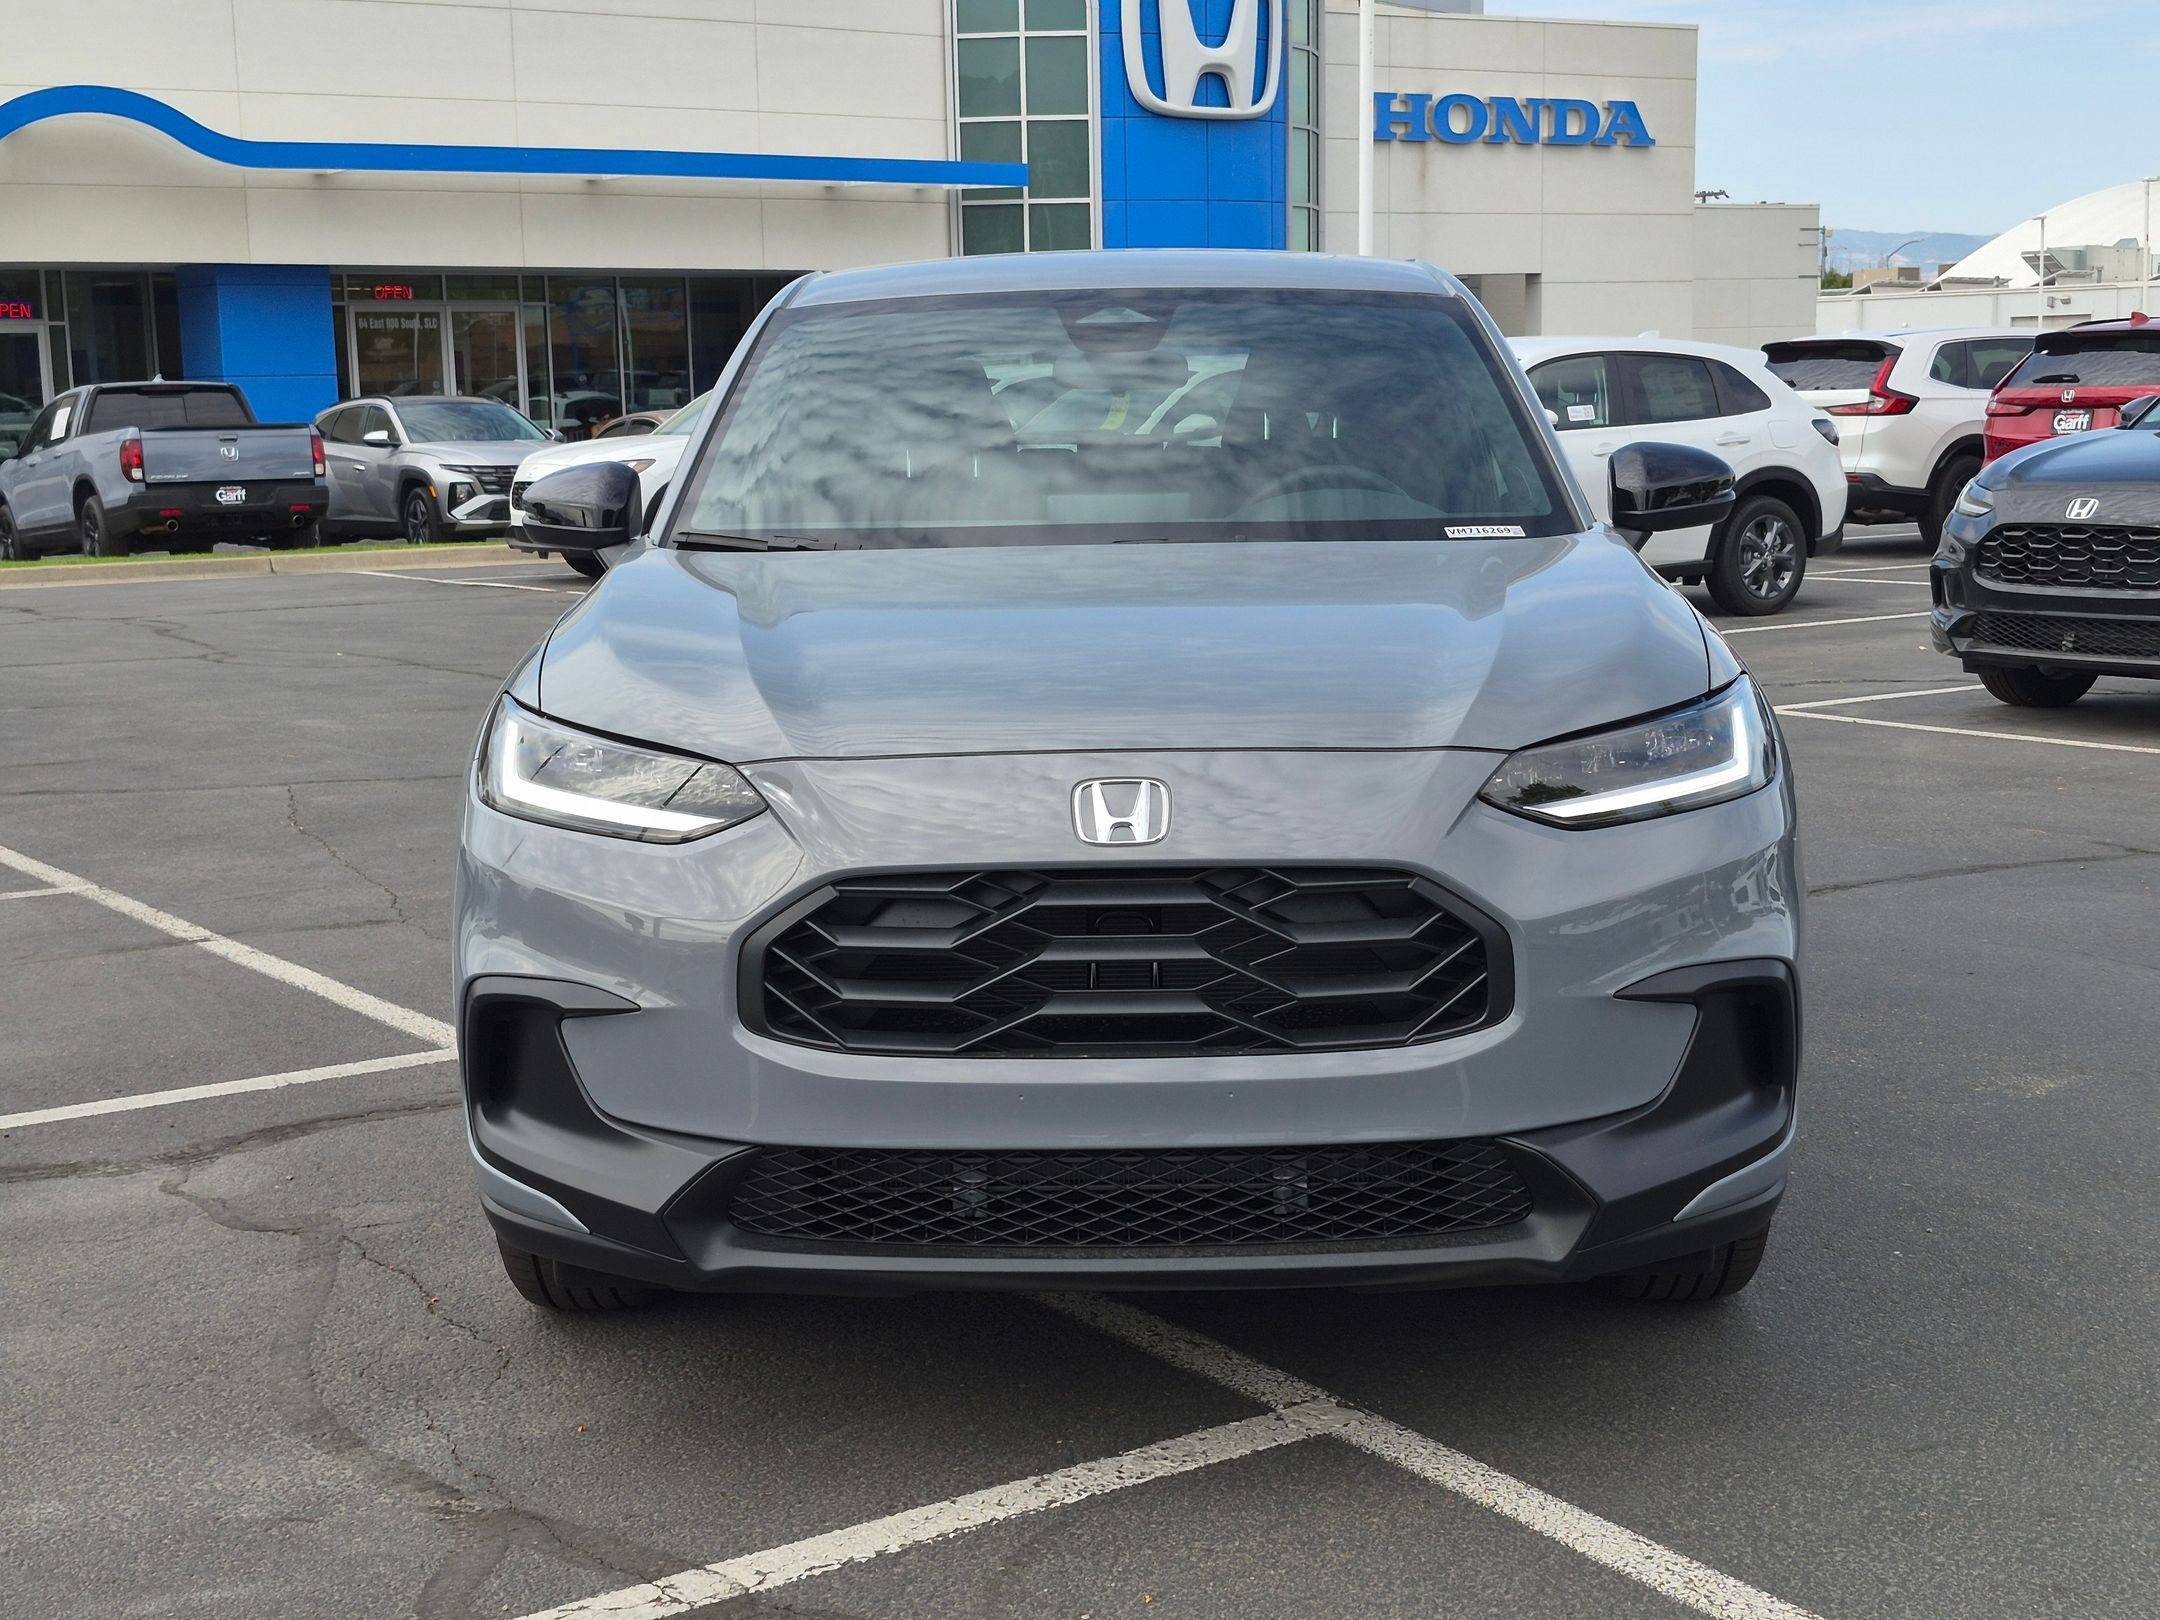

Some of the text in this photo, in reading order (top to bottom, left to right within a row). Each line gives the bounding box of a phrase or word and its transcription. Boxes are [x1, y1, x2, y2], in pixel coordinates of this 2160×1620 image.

[1373, 91, 1656, 148] HONDA
[374, 285, 413, 300] OPEN
[2053, 414, 2090, 430] Garff
[215, 489, 246, 502] Garff
[1447, 527, 1511, 535] VM716269
